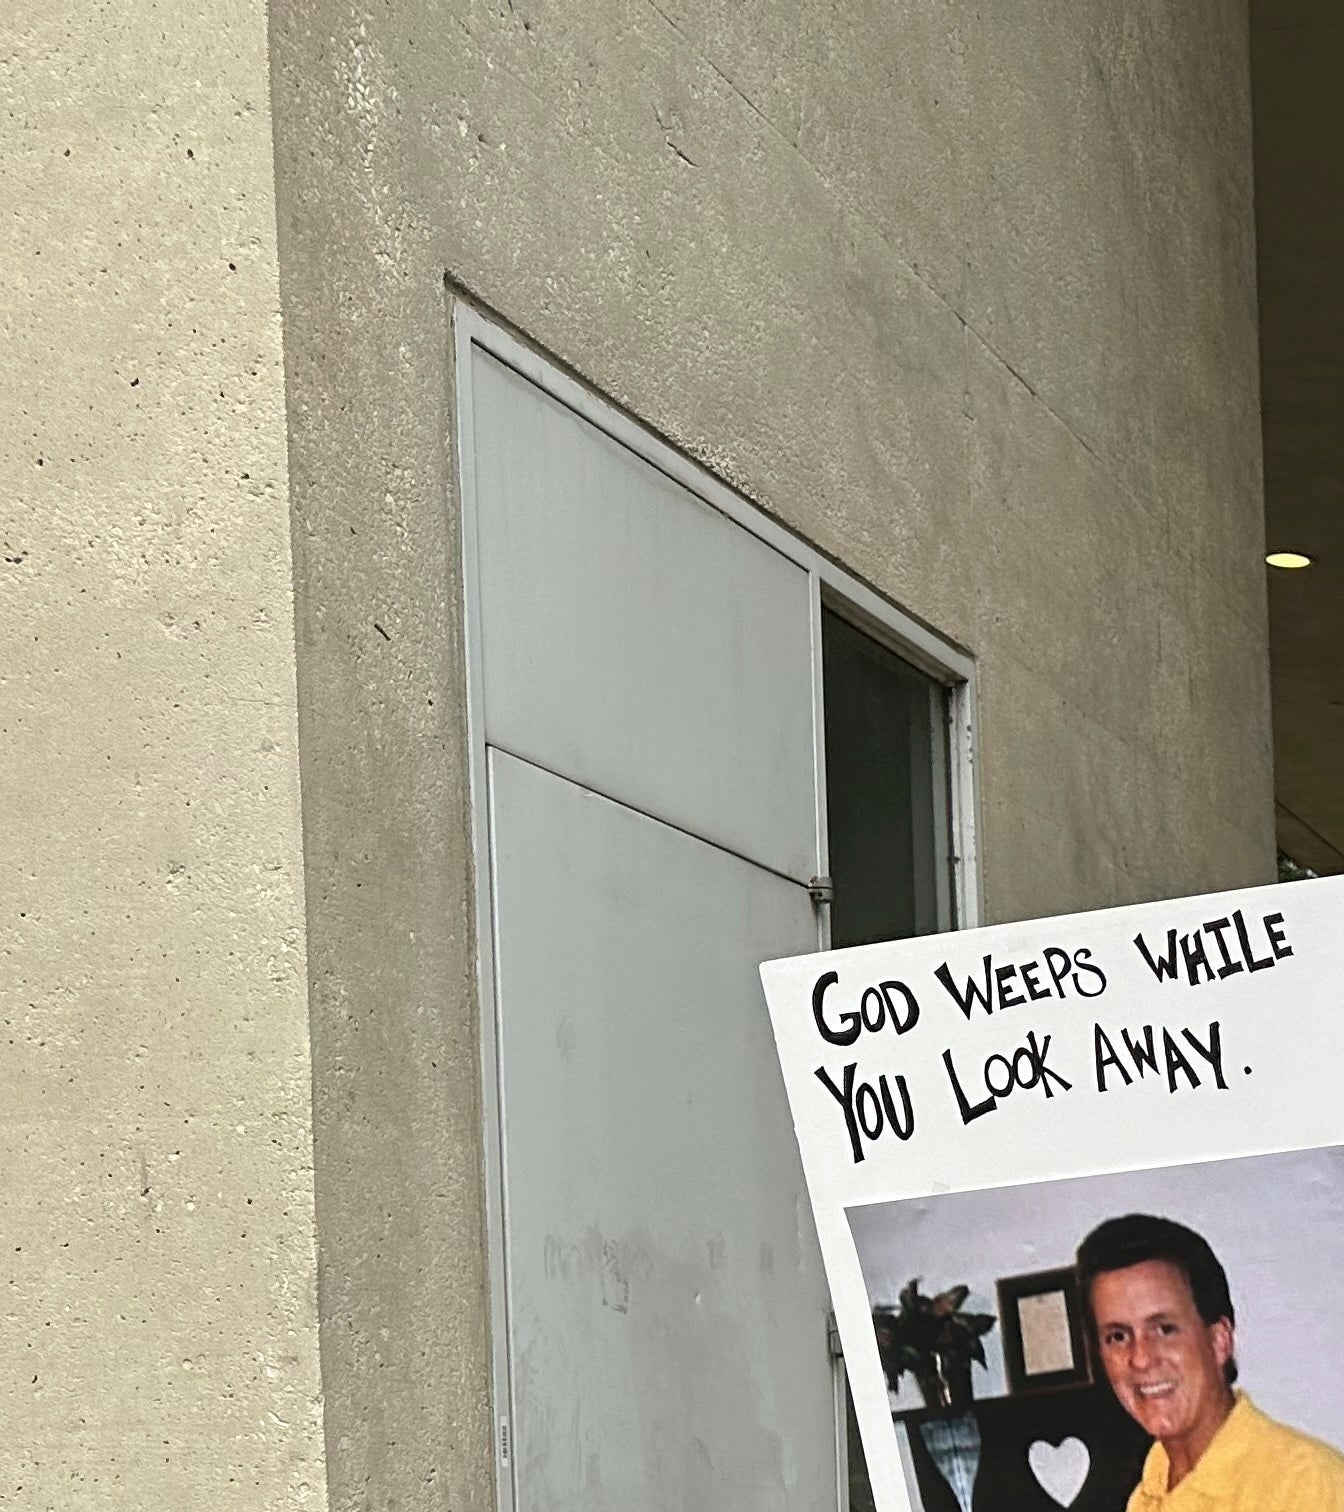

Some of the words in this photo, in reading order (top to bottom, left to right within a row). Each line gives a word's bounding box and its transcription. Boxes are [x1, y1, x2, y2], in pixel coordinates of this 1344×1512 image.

[811, 971, 920, 1047] GOD
[933, 947, 1107, 1021] WEEPS
[1133, 910, 1295, 987] WHILE
[813, 1062, 915, 1164] YOU
[941, 1030, 1073, 1126] LOOK
[1094, 1020, 1253, 1094] AWAY.
